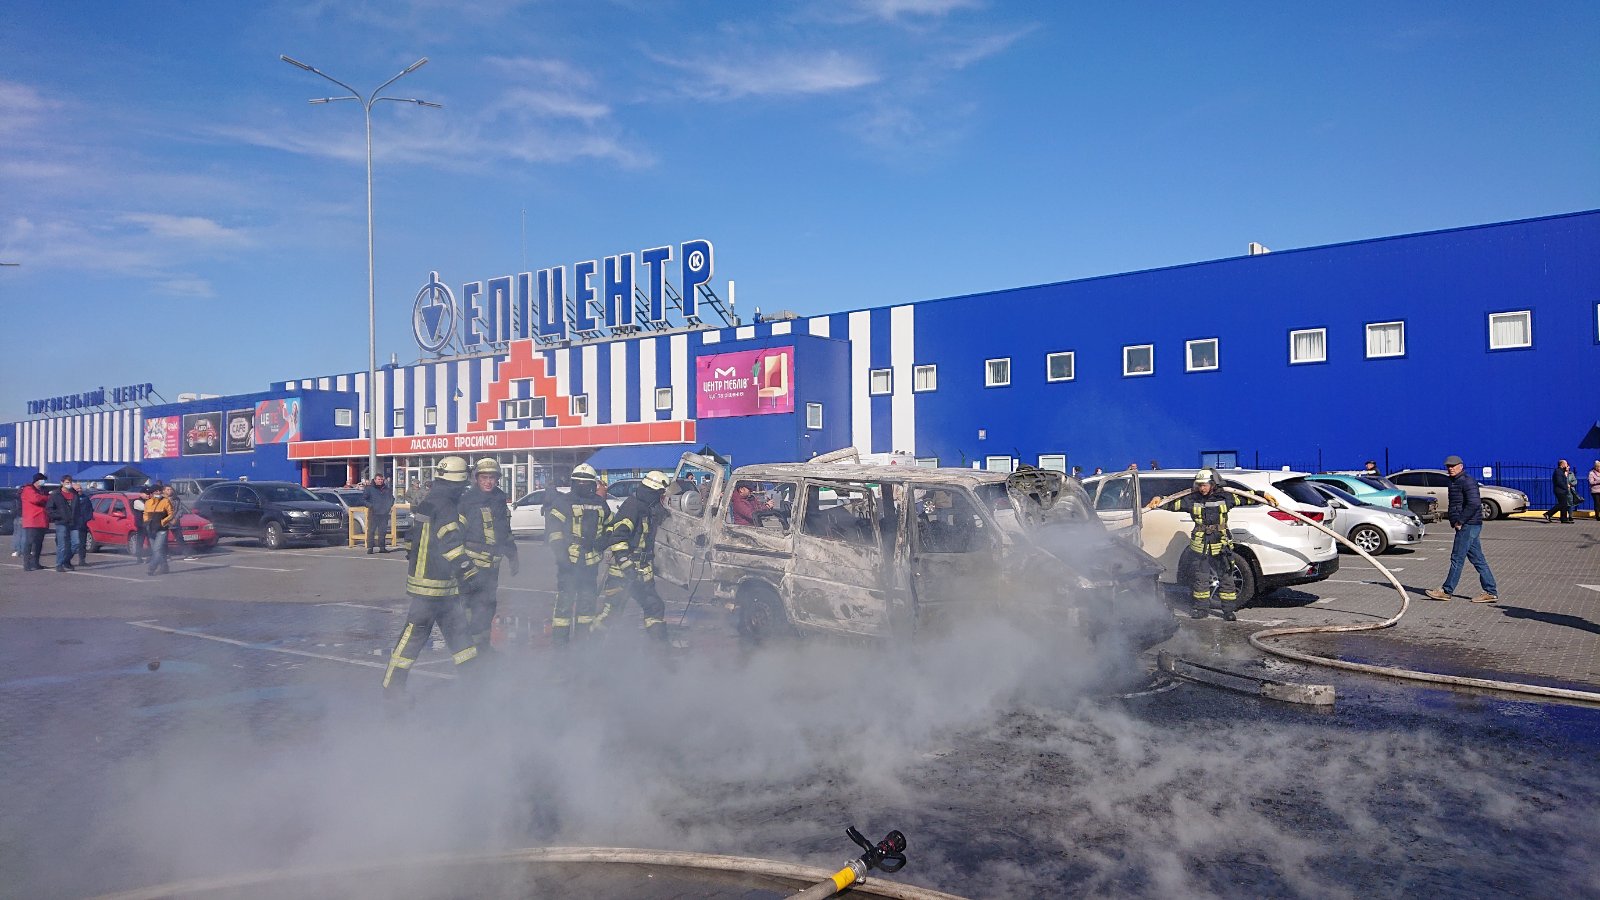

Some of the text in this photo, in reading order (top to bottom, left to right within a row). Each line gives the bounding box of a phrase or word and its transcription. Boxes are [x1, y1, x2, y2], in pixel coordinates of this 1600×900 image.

[462, 238, 714, 347] ЕПІЦЕНТР
[703, 378, 748, 393] ЦЕНТР МЕБЛІВ
[26, 382, 153, 415] ТОРГОВЕЛЬНИЙ ЦЕНТР
[410, 434, 497, 450] ЛАСКАВО ПРОСИМО!
